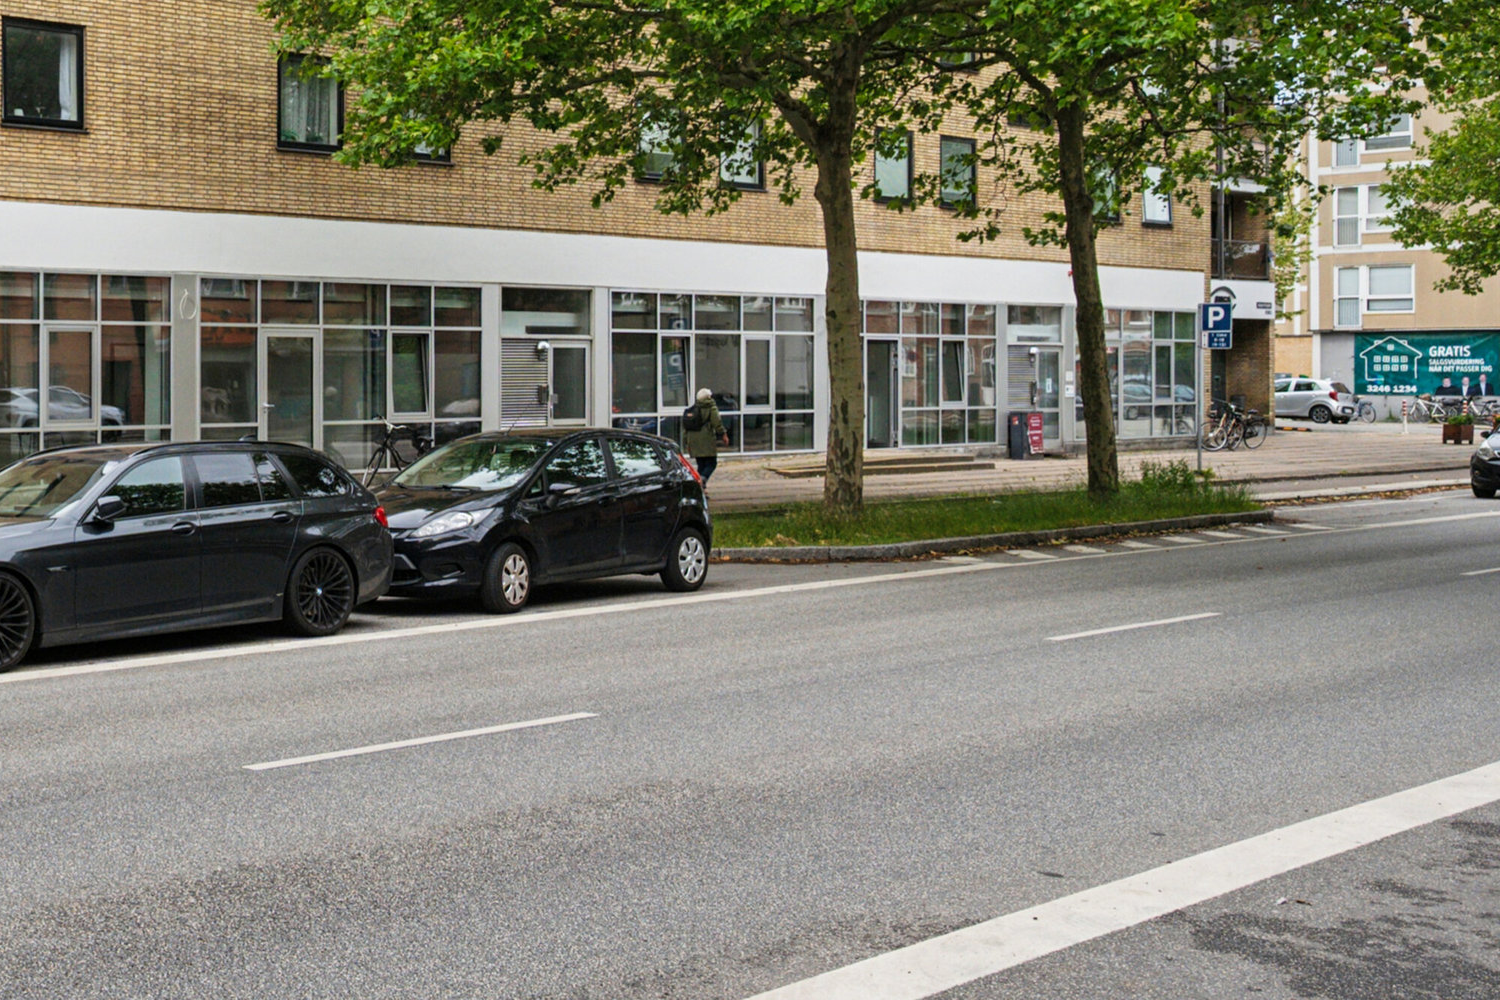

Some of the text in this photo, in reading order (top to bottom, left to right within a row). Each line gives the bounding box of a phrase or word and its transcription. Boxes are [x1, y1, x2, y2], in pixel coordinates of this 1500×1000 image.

[1208, 306, 1225, 329] P
[1429, 345, 1471, 357] GRATIS
[1393, 385, 1417, 393] 1234
